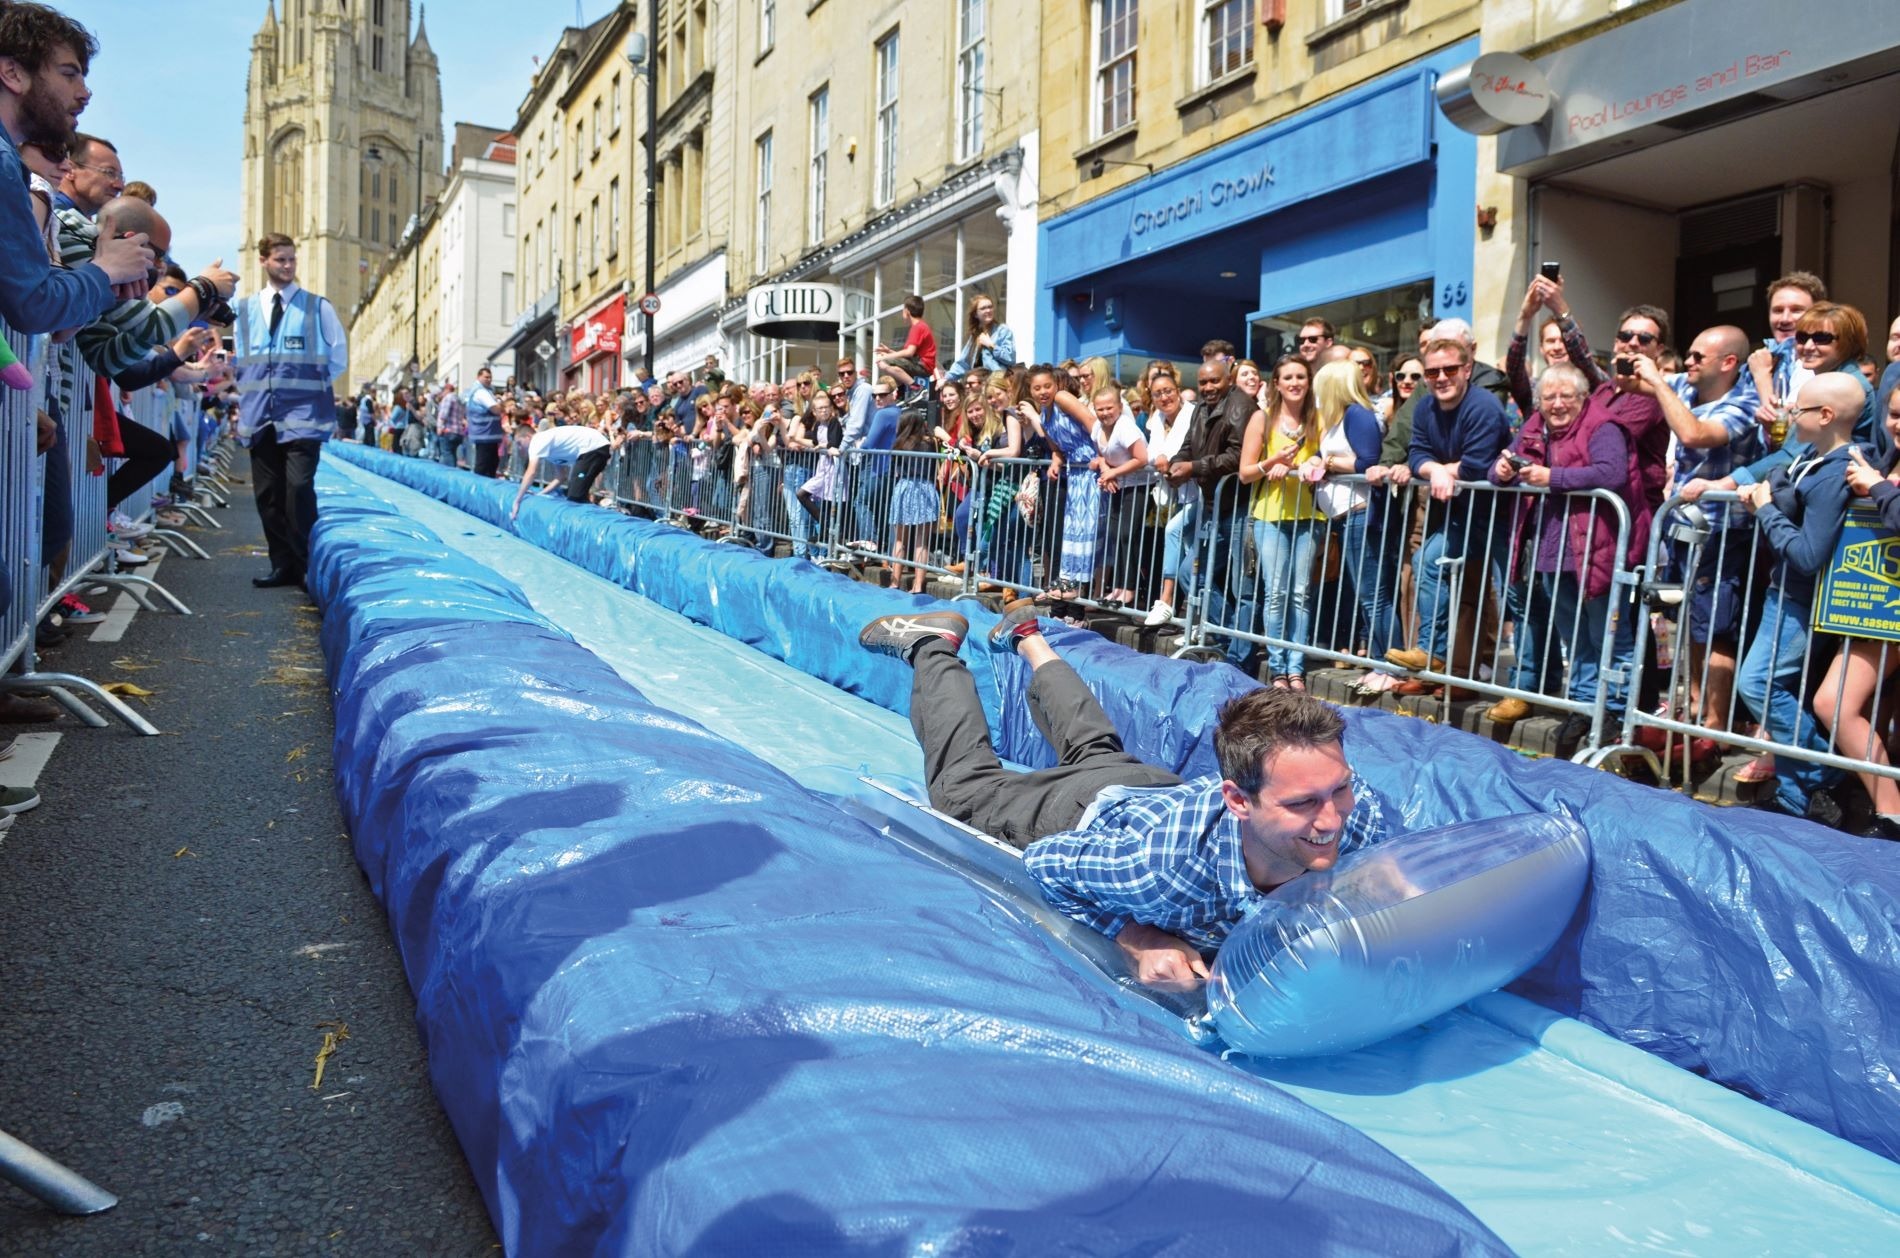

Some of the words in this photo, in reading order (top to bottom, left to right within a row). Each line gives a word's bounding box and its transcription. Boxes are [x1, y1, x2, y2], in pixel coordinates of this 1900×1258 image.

[1568, 105, 1607, 134] Pool
[1612, 84, 1688, 120] Lounge
[1695, 61, 1738, 92] and
[1744, 50, 1791, 77] Bar
[1132, 189, 1203, 236] Chandni
[1210, 160, 1276, 207] Chowk
[645, 300, 658, 308] 20
[1869, 584, 1889, 593] EVENT
[1832, 589, 1869, 600] EQUIPMENT
